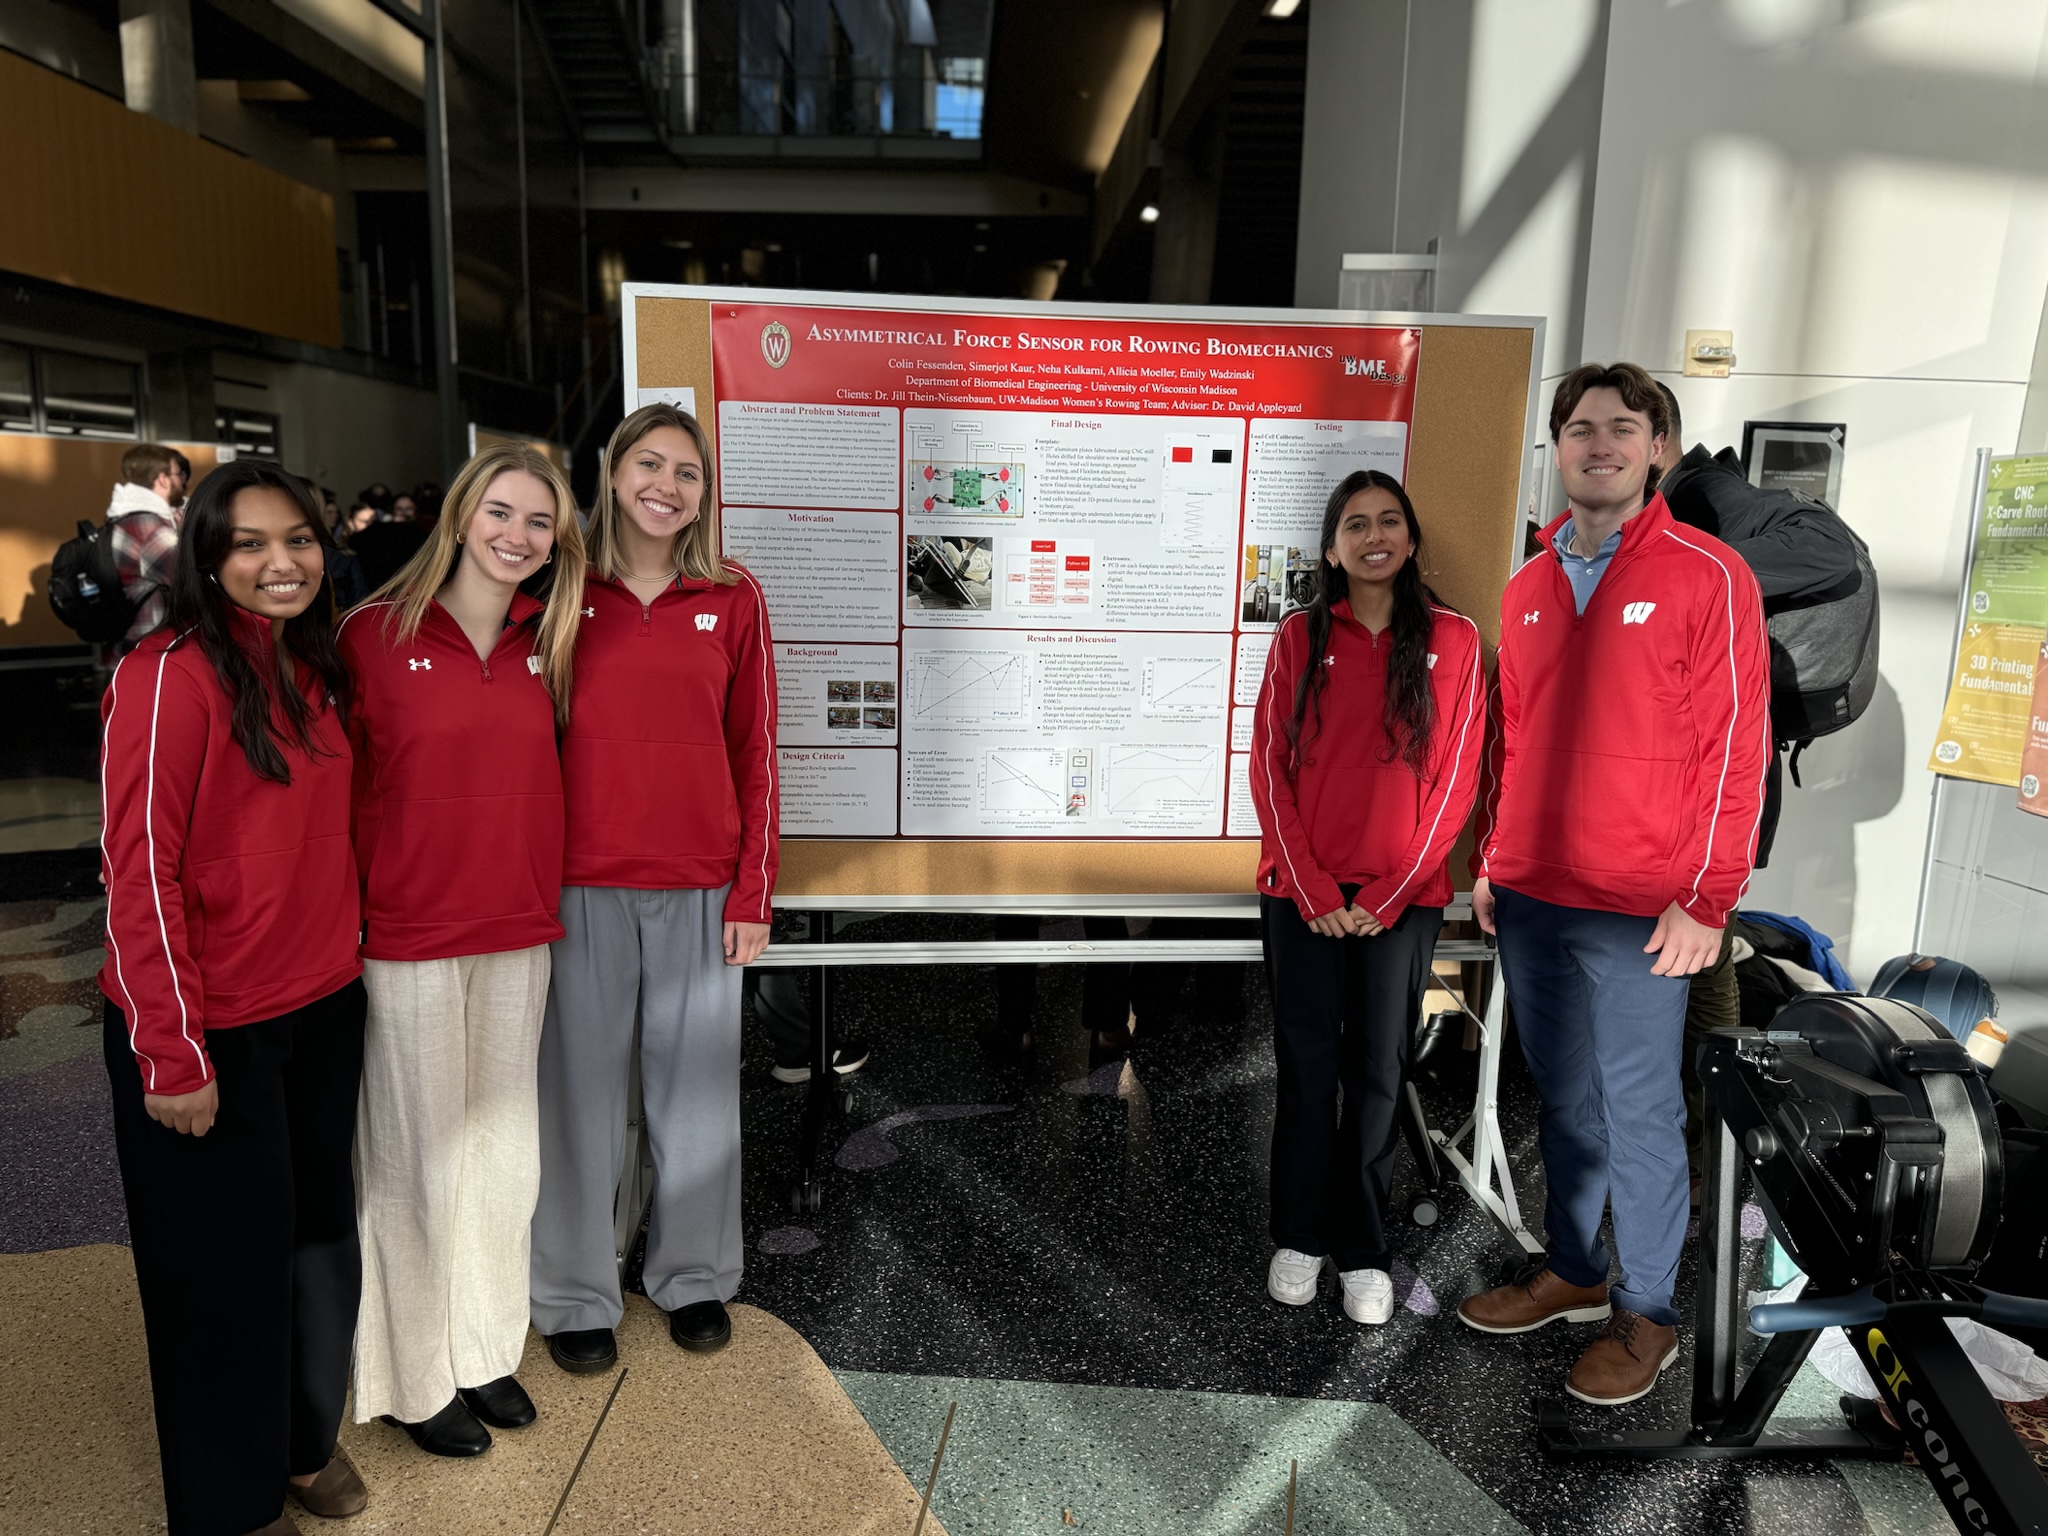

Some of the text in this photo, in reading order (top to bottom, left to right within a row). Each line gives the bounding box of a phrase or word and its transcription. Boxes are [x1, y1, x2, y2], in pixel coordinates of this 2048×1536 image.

[768, 336, 784, 359] W
[807, 323, 1333, 359] ASYMMETRICAL FORCE SENSOR FOR ROWING BIOMECHANICS
[888, 358, 1255, 380] Colin Fessenden, Simerjot Kaur, Neha Kulkarni, Allicia Moeller, Emily Wadzinski
[1345, 359, 1386, 375] BME
[1371, 371, 1406, 383] Design
[905, 375, 959, 389] Department
[961, 377, 972, 387] of
[973, 378, 1025, 389] Biomedical
[1027, 380, 1082, 393] Engineering
[1091, 382, 1137, 394] University
[1139, 383, 1150, 393] of
[1152, 383, 1197, 394] Wisconsin
[1200, 385, 1238, 395] Madison
[836, 389, 1302, 414] Clients: Dr. Jill Thein-Nissenbaum, UW-Madison Women's Rowing Team; Advisor: Dr. David Appleyard
[740, 405, 880, 417] Abstract and Problem Statement
[1051, 419, 1102, 430] Final Design
[1314, 422, 1343, 432] Testing
[2014, 485, 2035, 500] CNC
[788, 513, 834, 523] Motivation
[1987, 504, 2048, 519] X-Carve Rout
[1622, 601, 1656, 625] W
[694, 614, 718, 632] W
[1027, 635, 1116, 643] Results and Discussion
[787, 648, 838, 657] Background
[1970, 655, 2033, 679] 3D Printing
[782, 752, 845, 761] Design Criteria
[1907, 1399, 1997, 1536] conc
